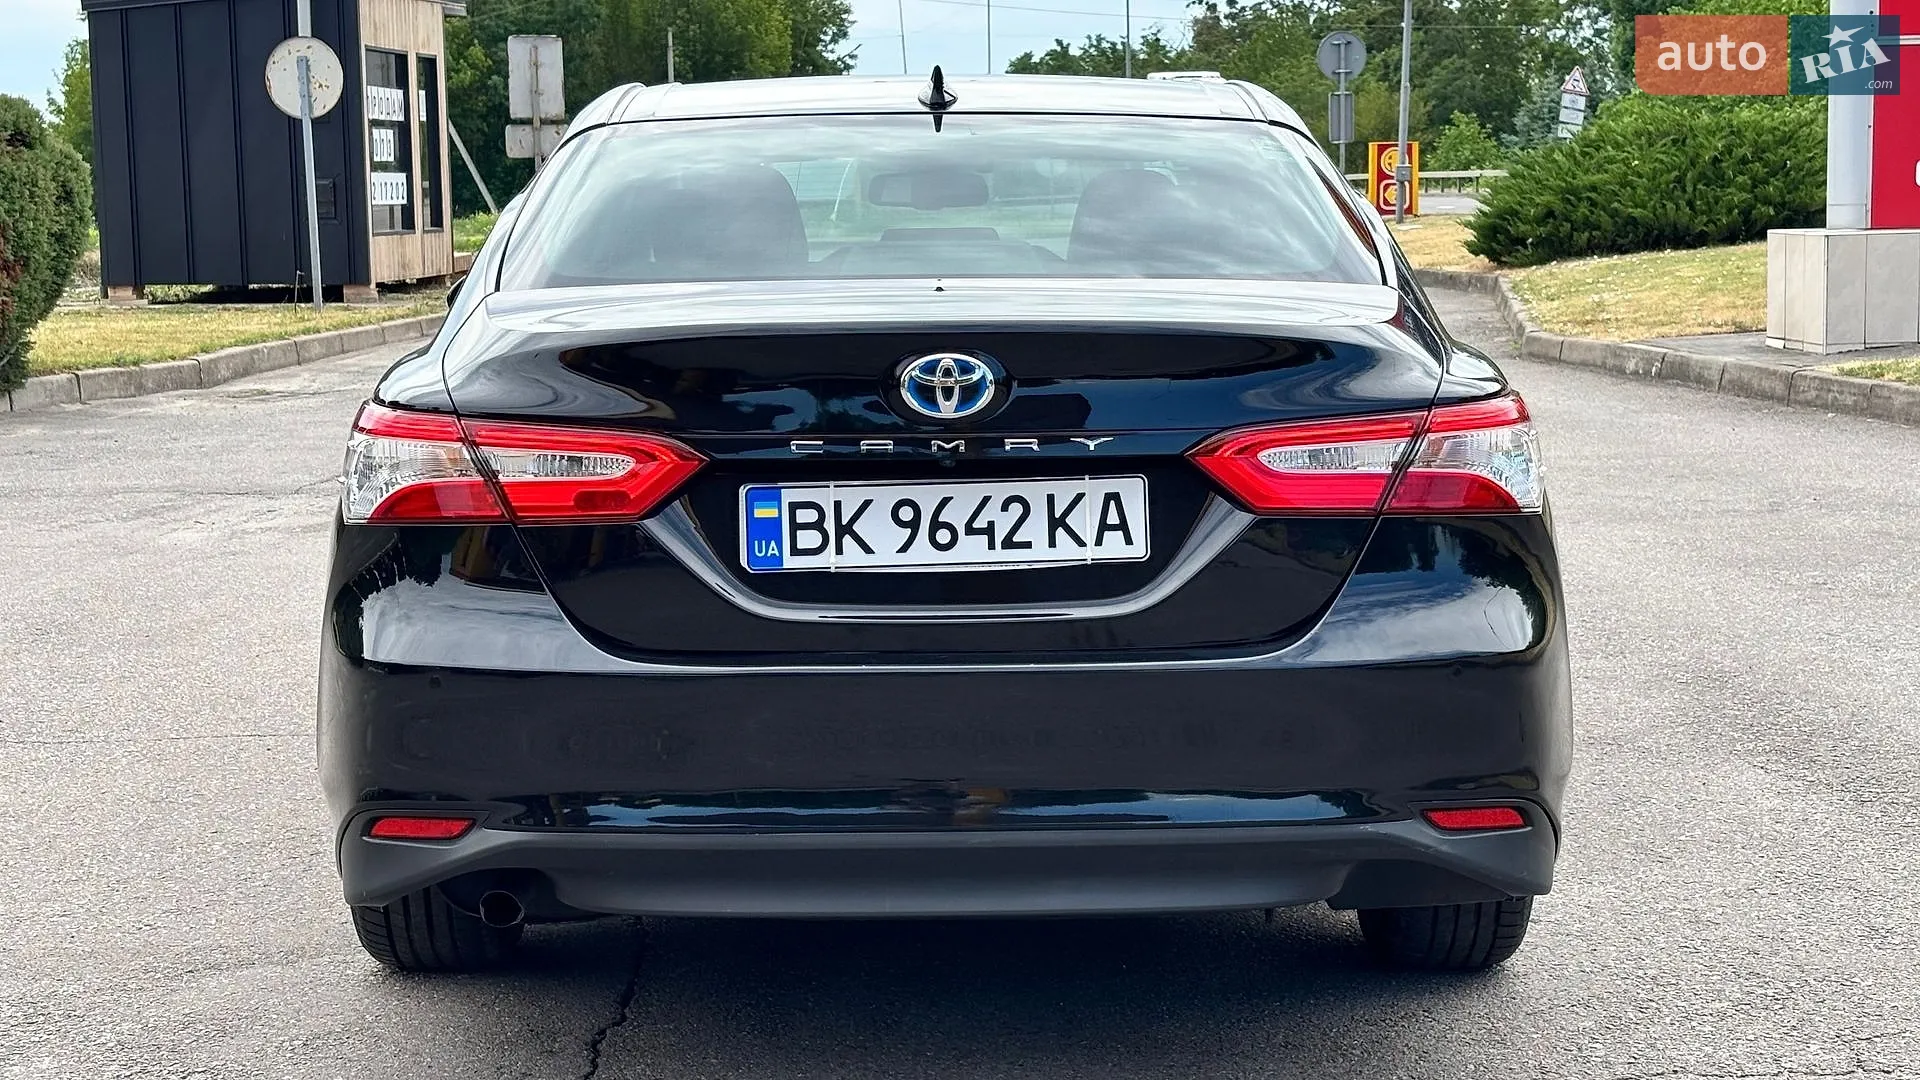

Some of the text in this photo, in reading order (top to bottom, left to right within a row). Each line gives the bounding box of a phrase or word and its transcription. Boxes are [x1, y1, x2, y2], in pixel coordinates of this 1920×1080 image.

[790, 437, 1114, 453] CAMRY
[788, 491, 1134, 556] BK 9642 KA
[754, 540, 780, 557] UA
